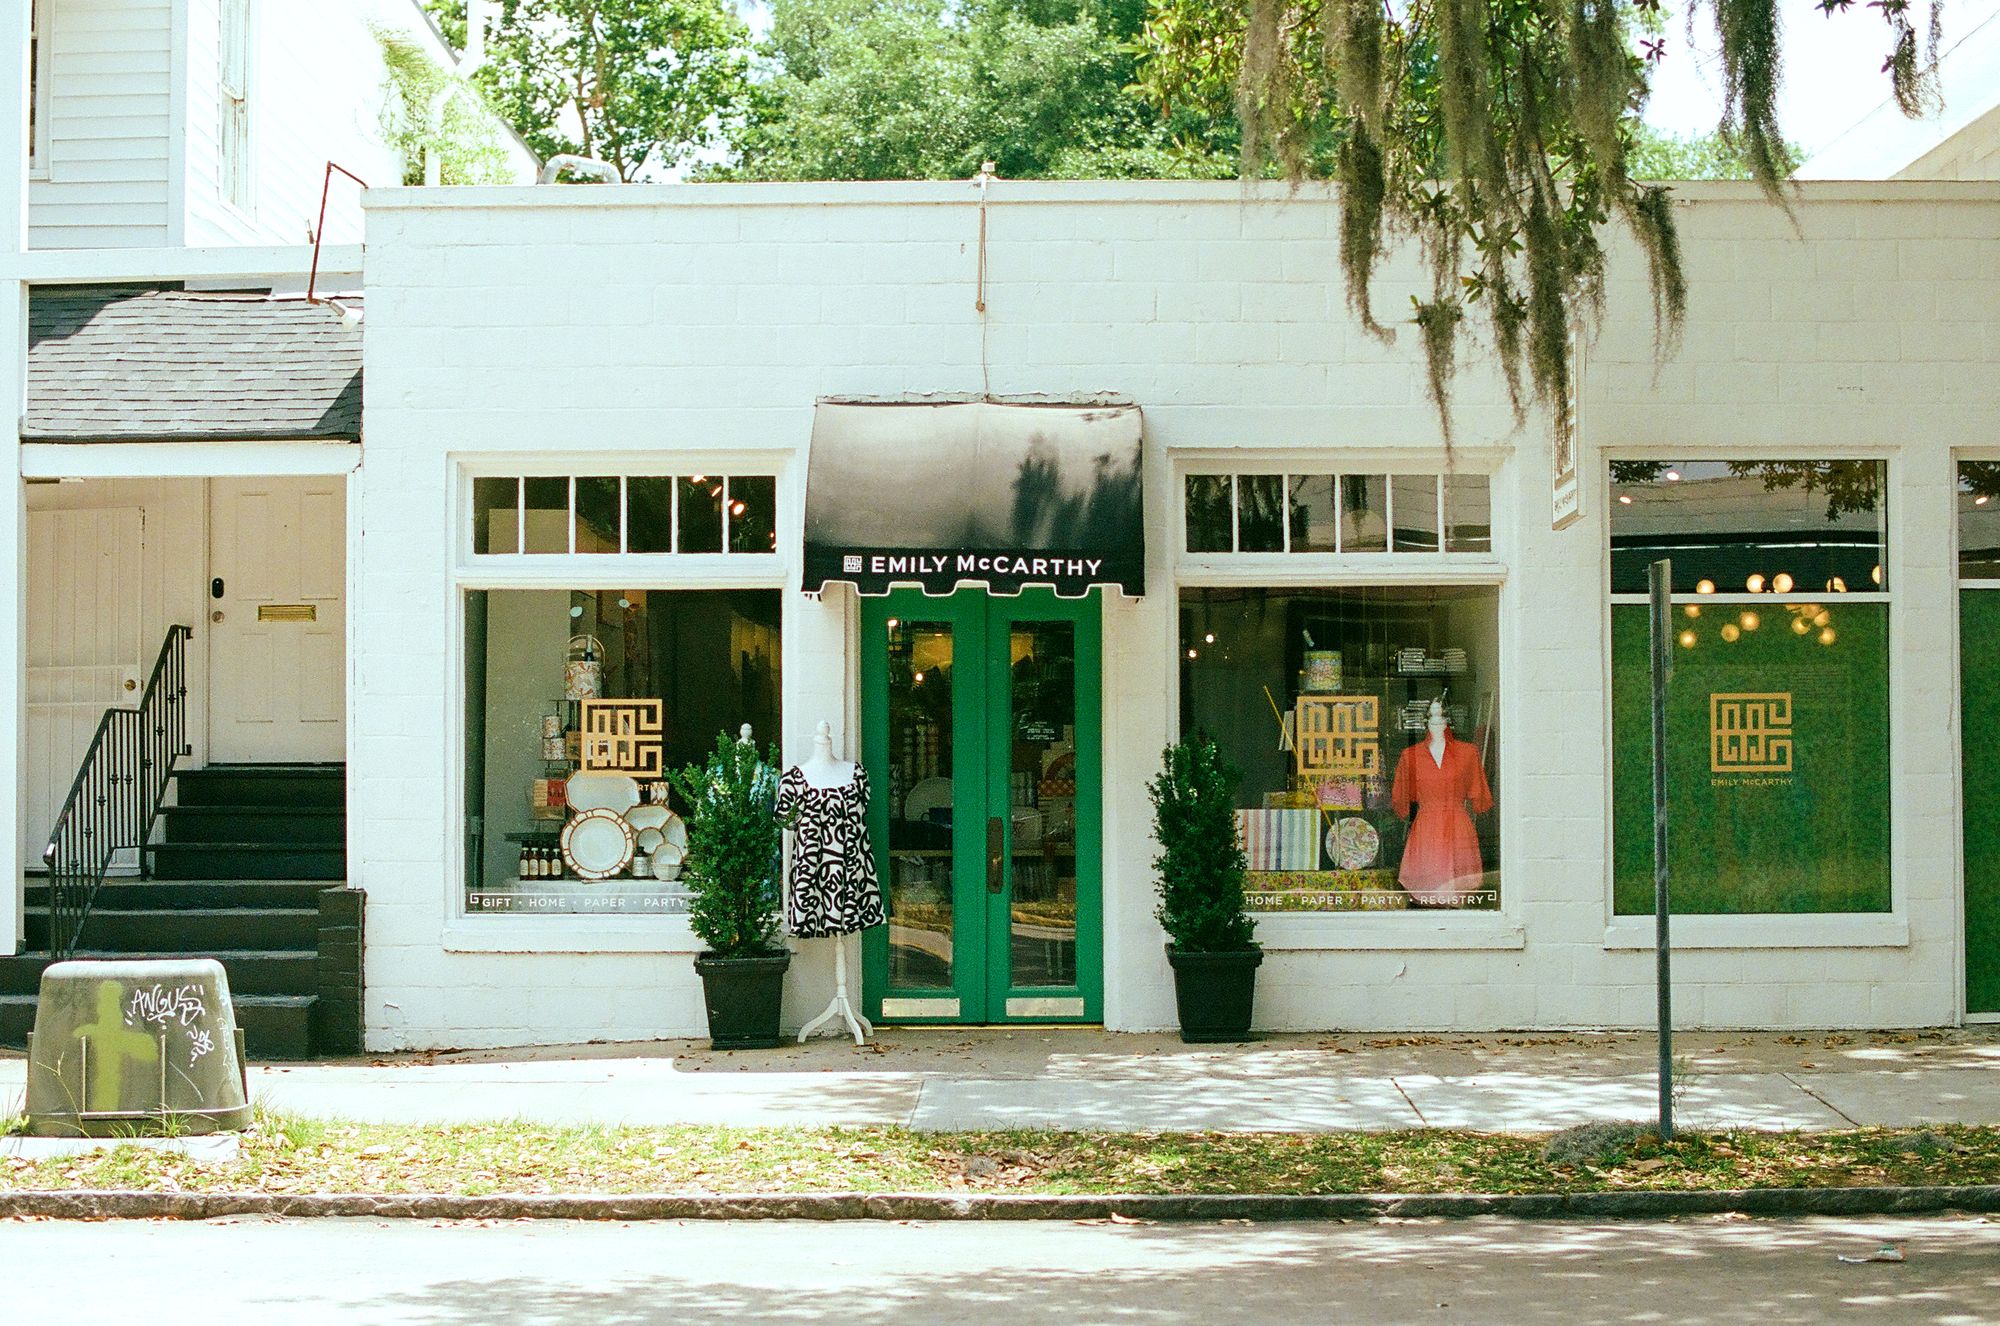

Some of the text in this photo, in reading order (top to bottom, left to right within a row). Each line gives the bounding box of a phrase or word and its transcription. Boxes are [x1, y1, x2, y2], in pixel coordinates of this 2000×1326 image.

[871, 554, 1101, 576] EMILY McCARTHY
[1711, 778, 1793, 786] EMILY McCARTHY
[482, 897, 685, 908] GIFT HOME PAPER PARTY
[1245, 895, 1484, 905] HOME PAPER PARTY REGISTRY
